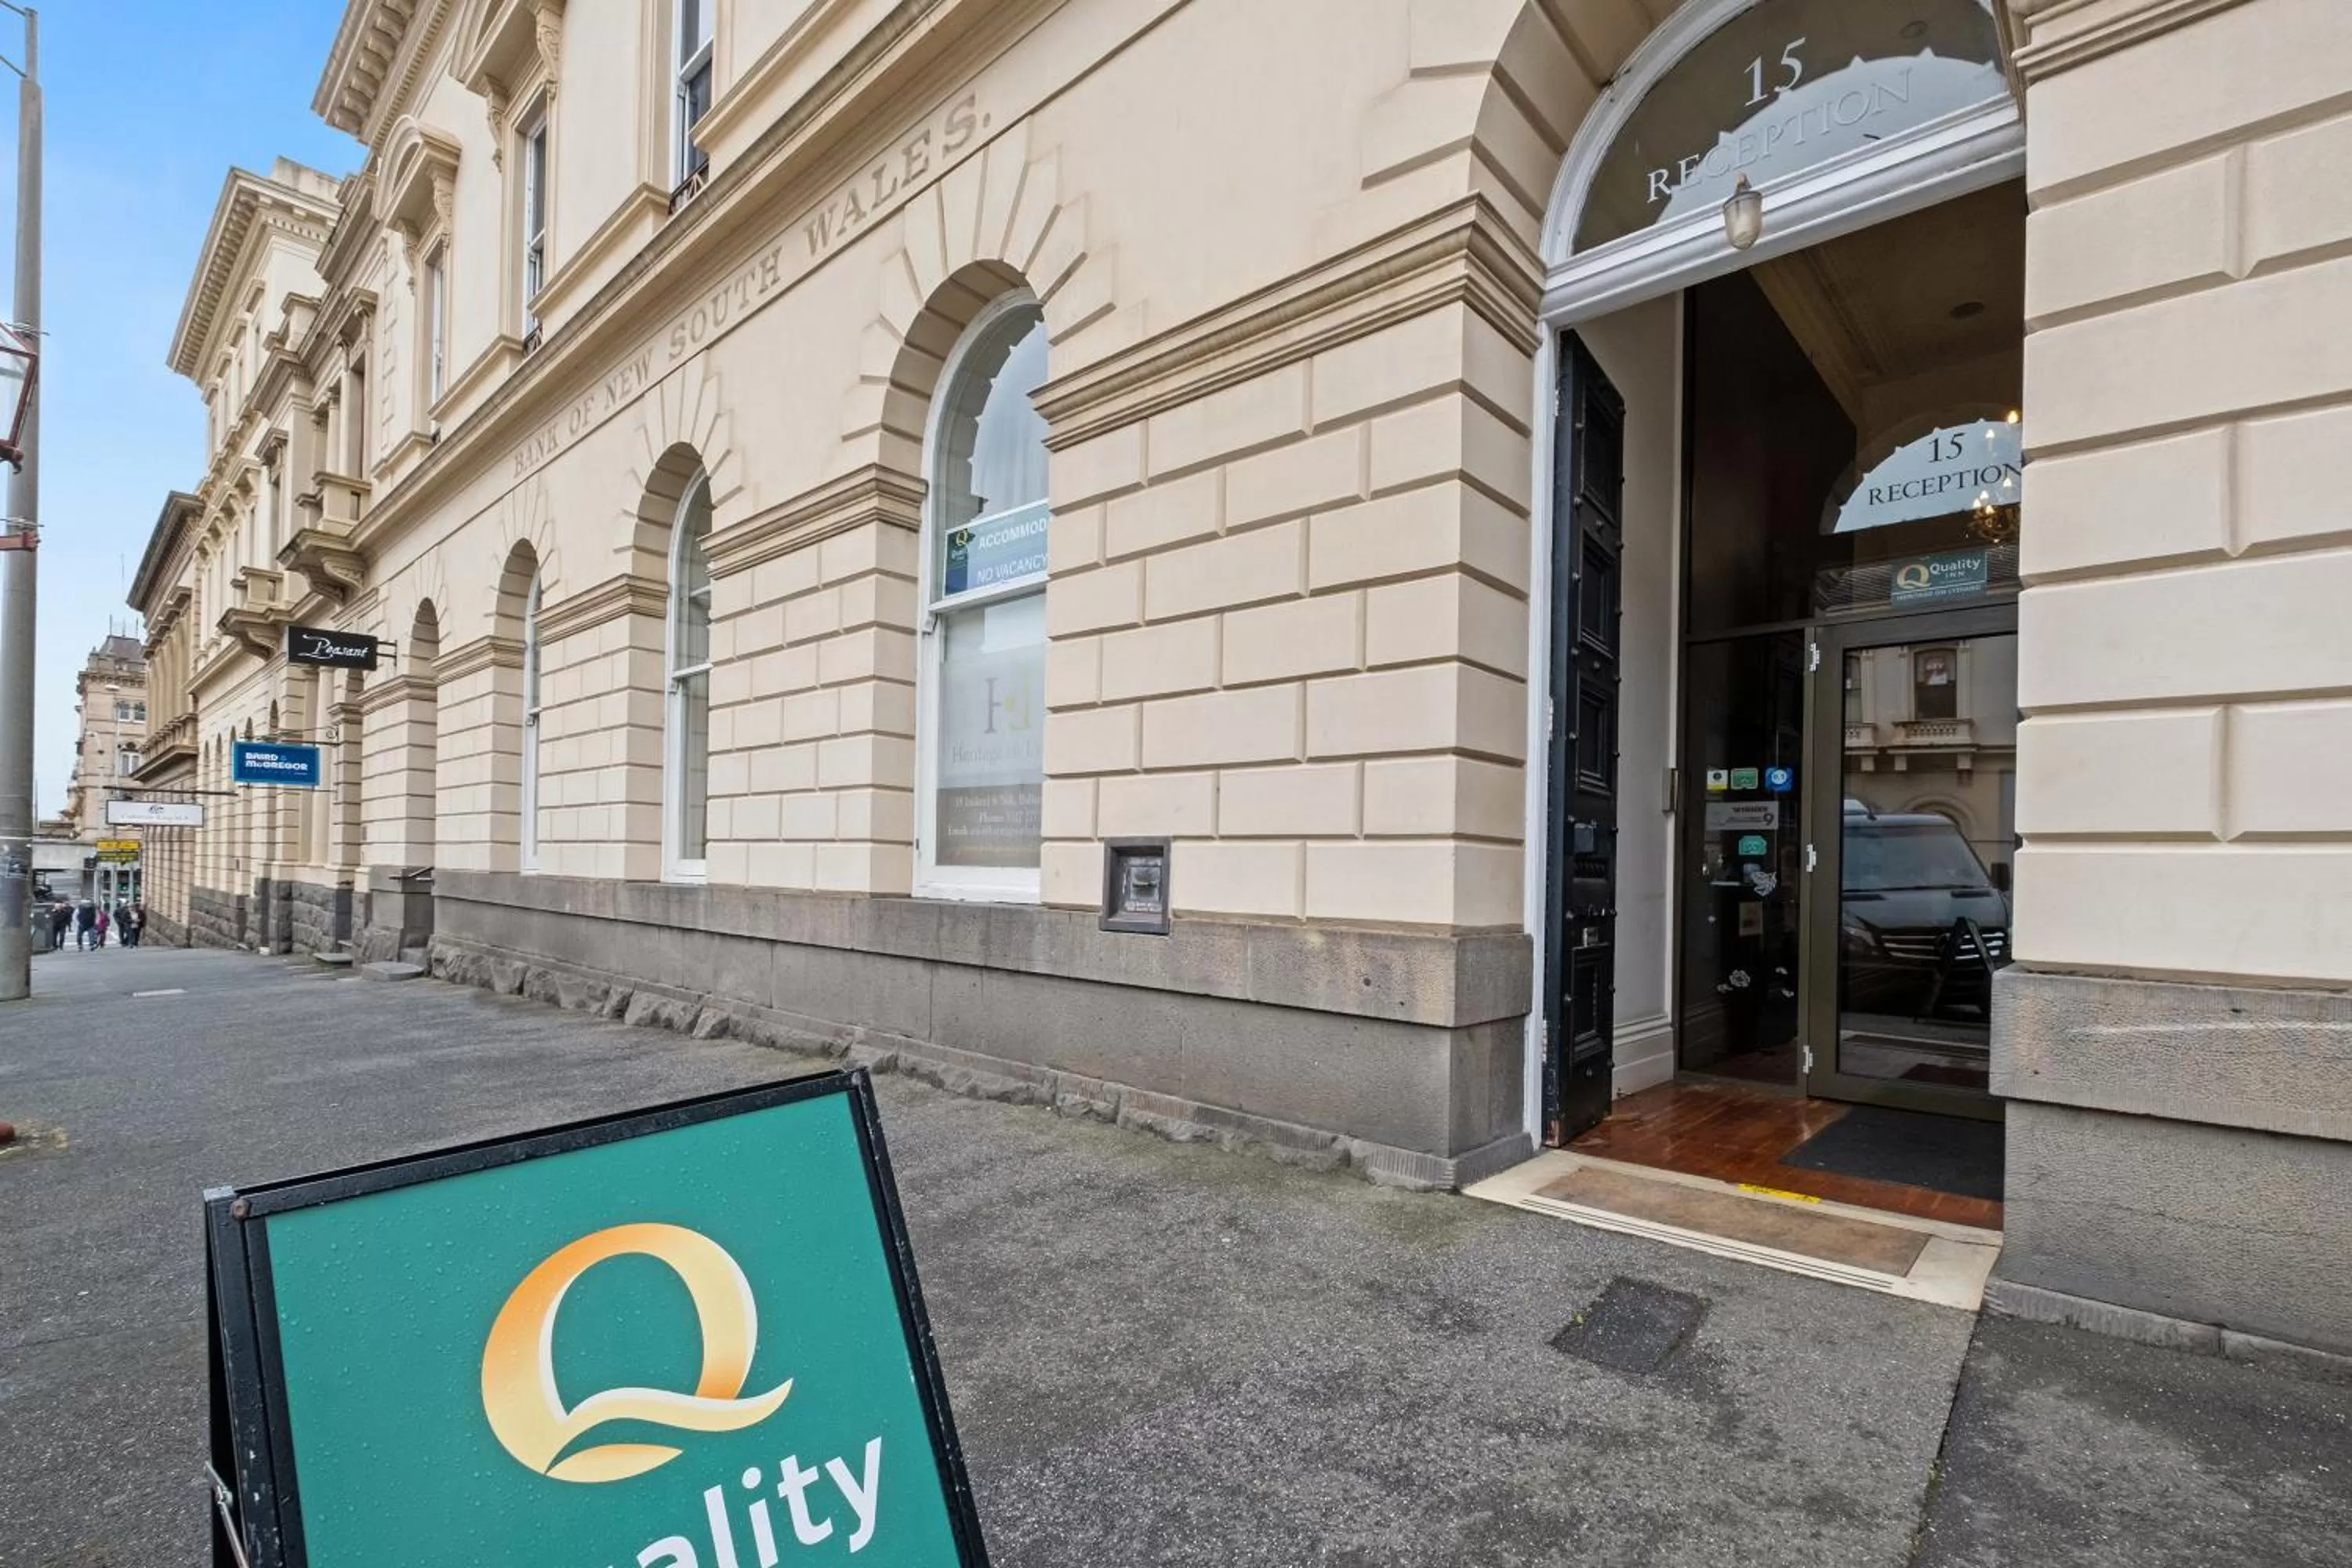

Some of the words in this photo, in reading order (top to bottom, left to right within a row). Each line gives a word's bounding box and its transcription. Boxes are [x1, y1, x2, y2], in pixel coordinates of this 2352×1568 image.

[1744, 37, 1806, 107] 15
[1646, 67, 1913, 204] RECEPTION
[568, 394, 594, 435] OF
[604, 344, 652, 412] NEW
[668, 245, 783, 363] SOUTH
[801, 92, 991, 259] WALES.
[1928, 432, 1965, 463] 15
[977, 566, 993, 584] NO
[1929, 558, 1981, 575] Quality
